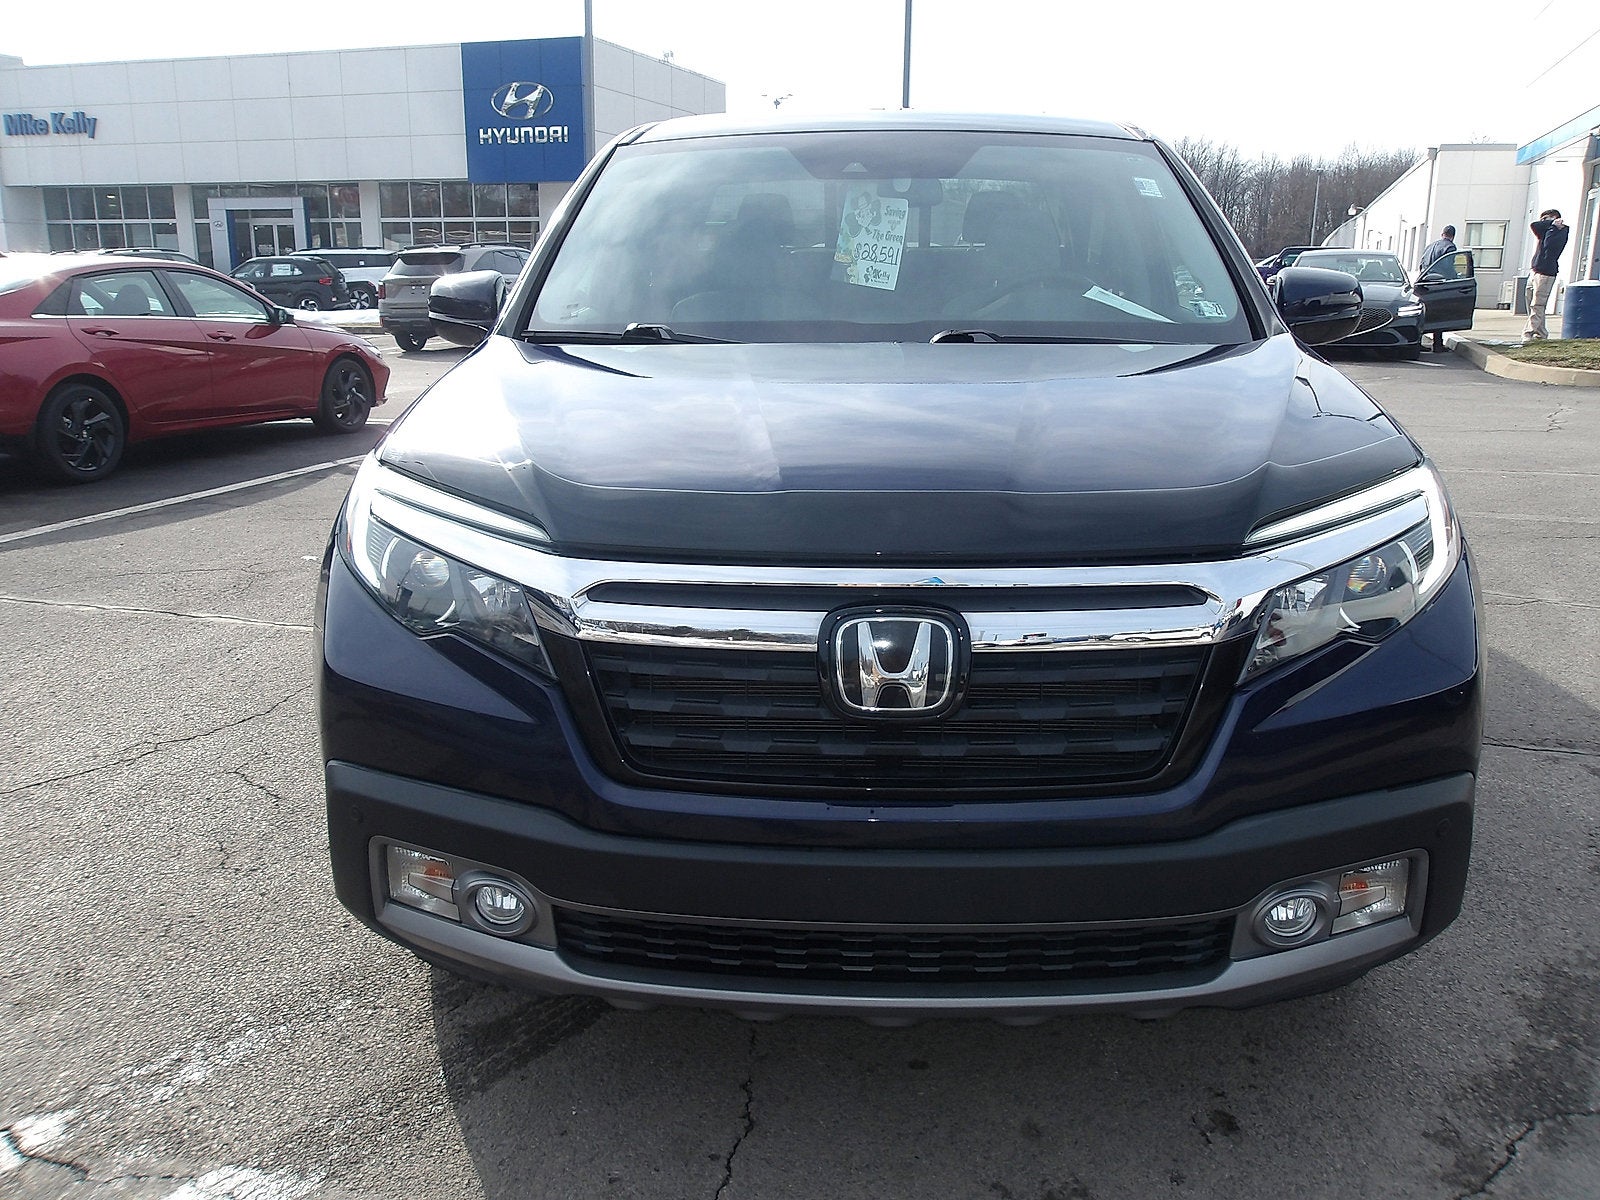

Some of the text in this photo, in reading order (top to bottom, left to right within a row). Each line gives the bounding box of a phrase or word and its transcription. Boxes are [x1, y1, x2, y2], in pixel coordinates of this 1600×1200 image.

[3, 111, 97, 139] Mike Kelly
[479, 126, 569, 145] HYUNDAI
[872, 228, 903, 245] The Green
[854, 242, 900, 265] $28,591
